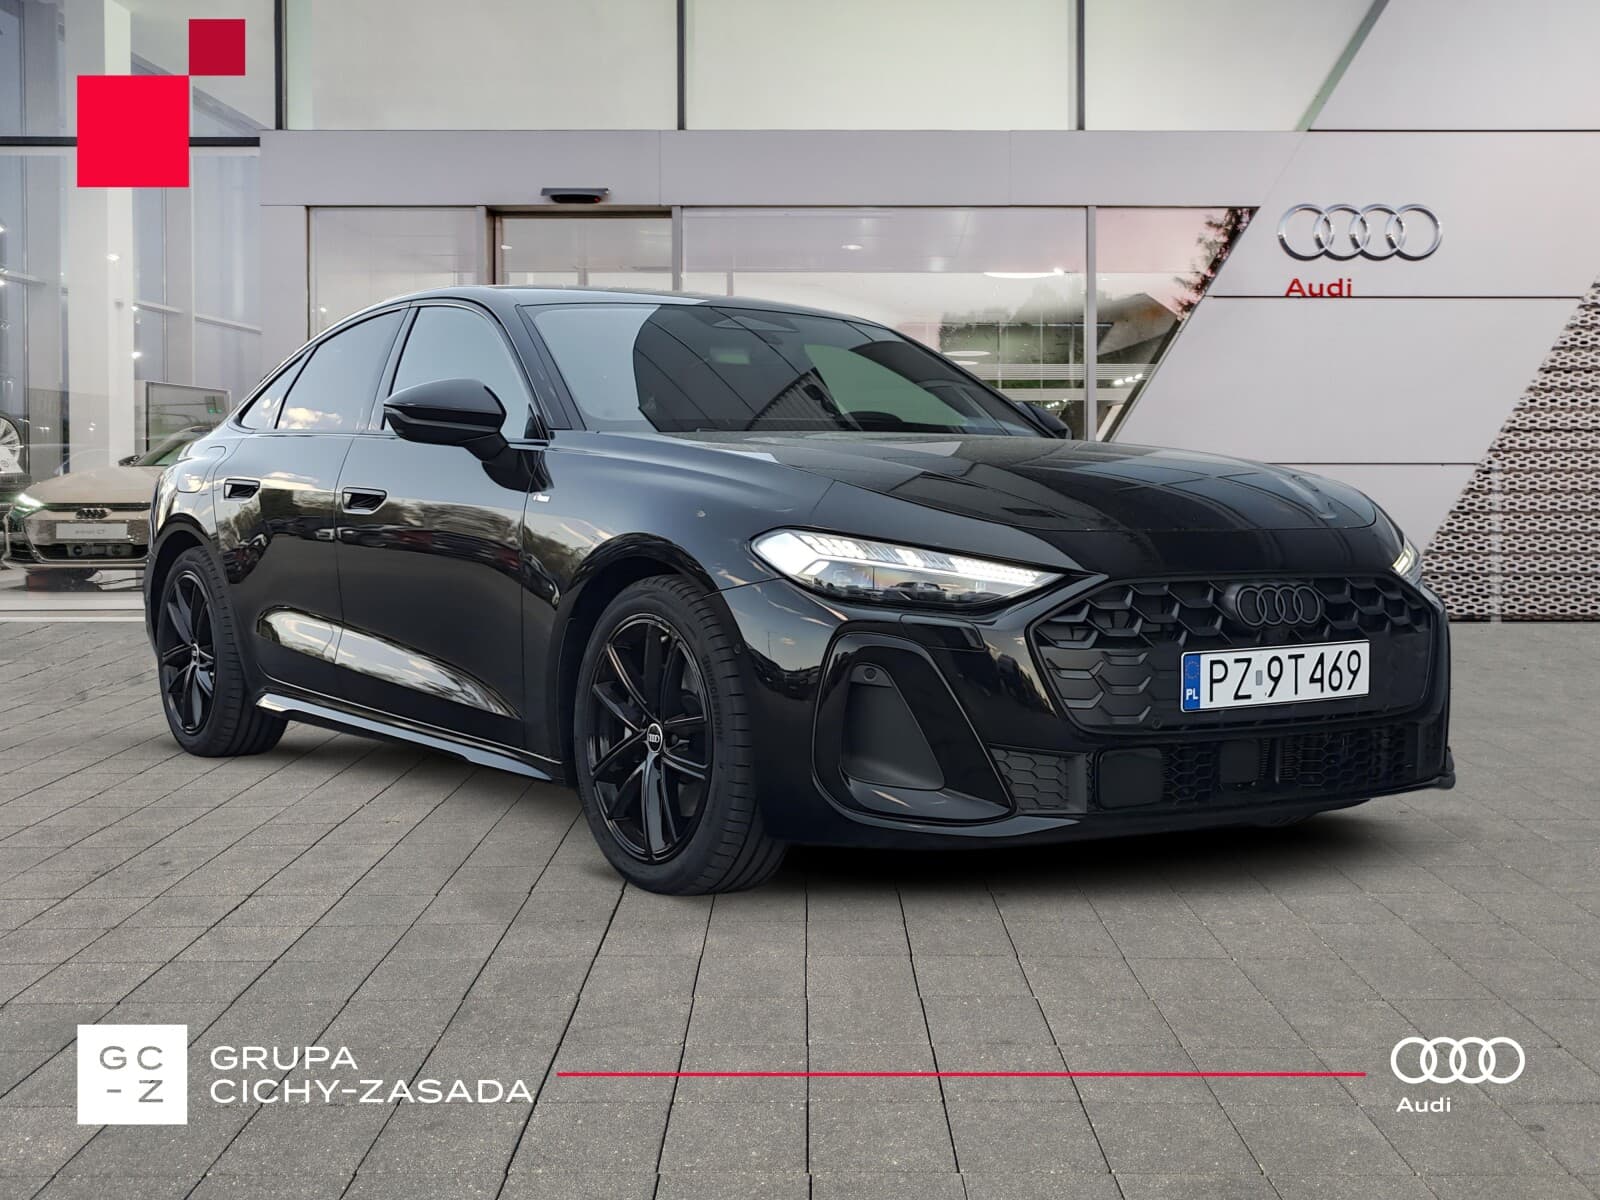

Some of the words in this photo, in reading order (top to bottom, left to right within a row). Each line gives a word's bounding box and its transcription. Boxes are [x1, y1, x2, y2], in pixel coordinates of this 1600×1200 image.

[1285, 277, 1353, 298] Audi
[1208, 657, 1253, 702] PZ
[1266, 649, 1362, 698] 9T469
[1185, 688, 1199, 701] PL
